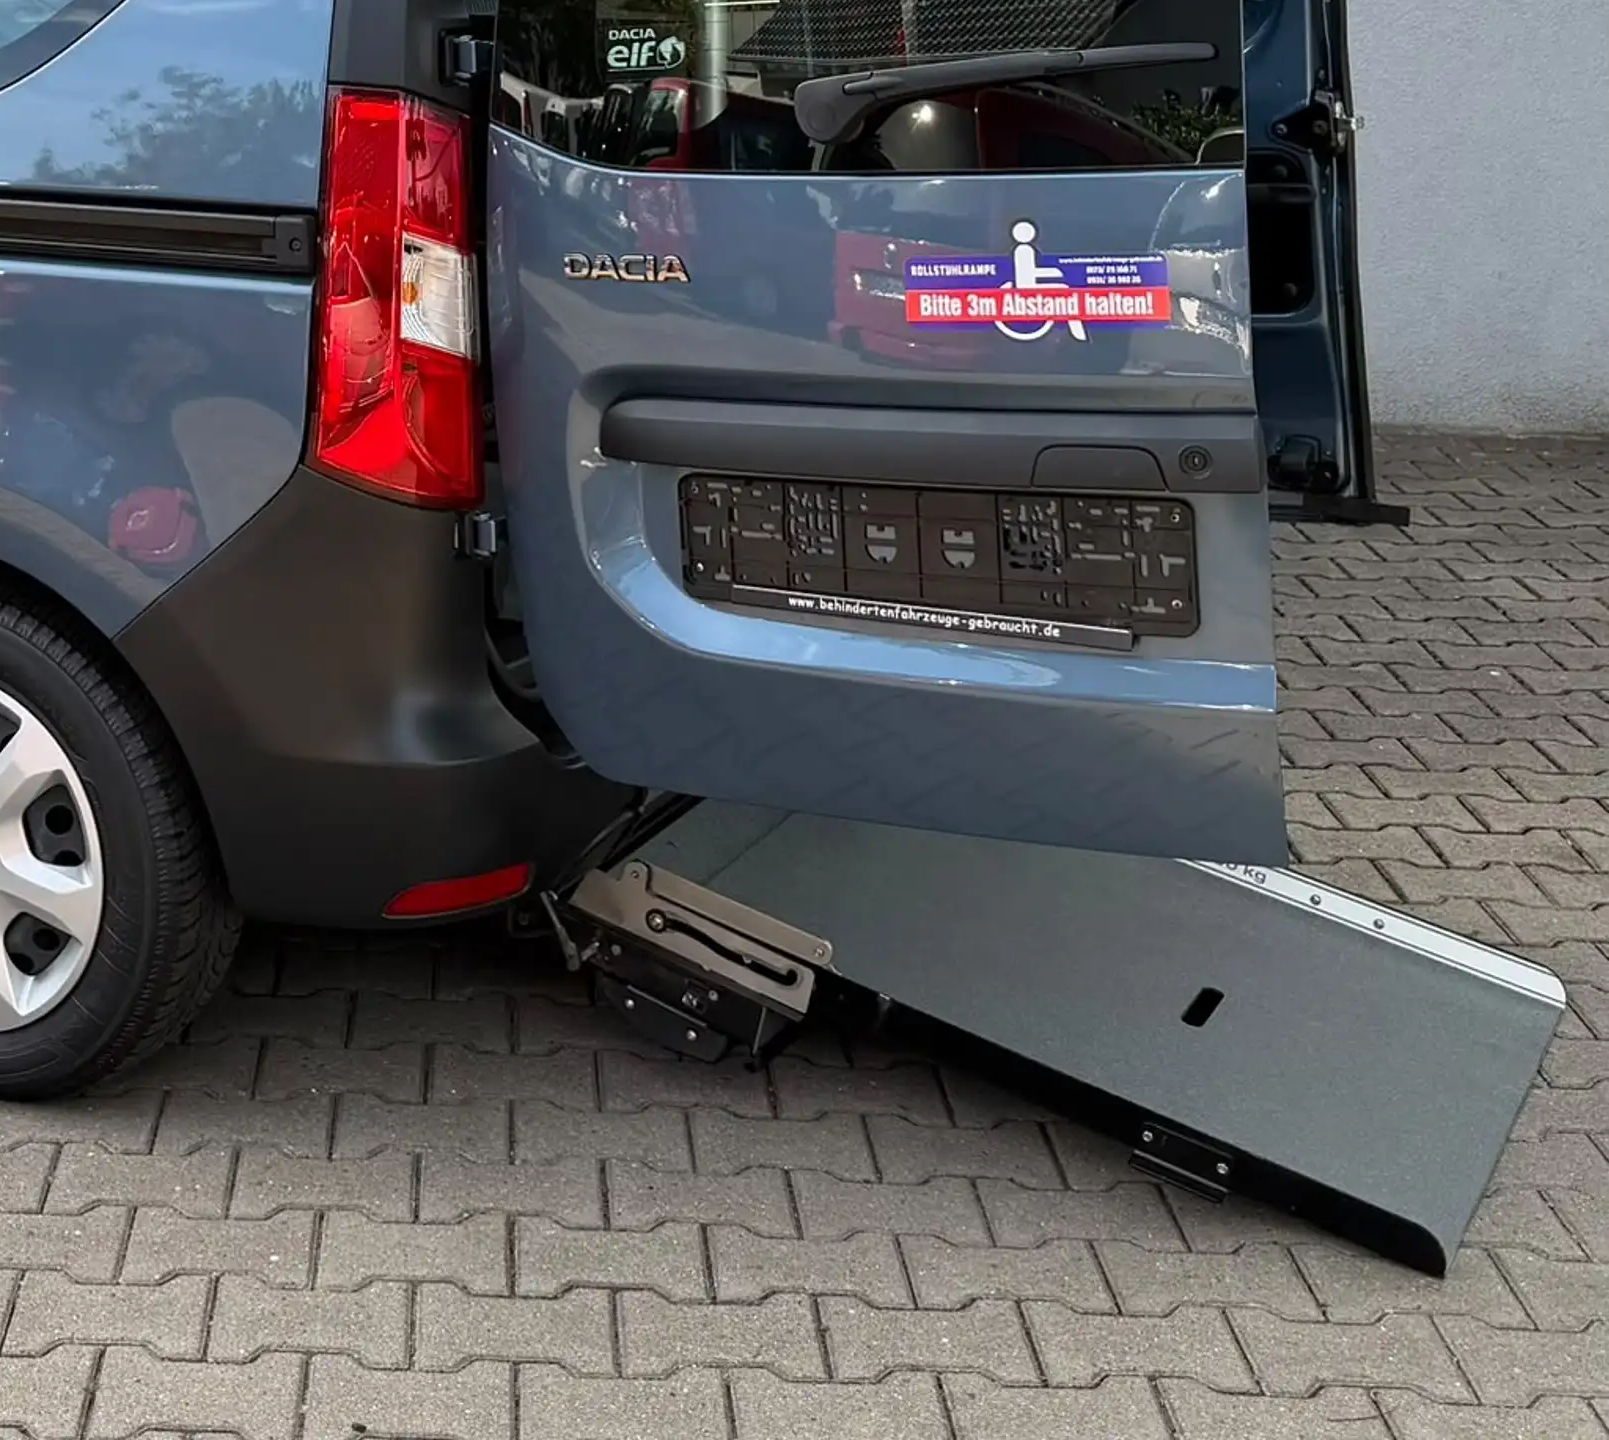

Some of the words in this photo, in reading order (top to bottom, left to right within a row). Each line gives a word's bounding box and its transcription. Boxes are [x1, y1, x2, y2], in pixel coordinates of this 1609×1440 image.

[608, 28, 656, 41] DACIA
[606, 41, 657, 68] elf
[563, 252, 690, 284] DACIA
[919, 293, 963, 317] Bitte
[966, 293, 997, 317] 3m
[1002, 292, 1079, 316] Abstand
[1084, 291, 1154, 315] halten!
[788, 596, 1061, 638] www.behindertenfahrzeuge-gebraucht.de
